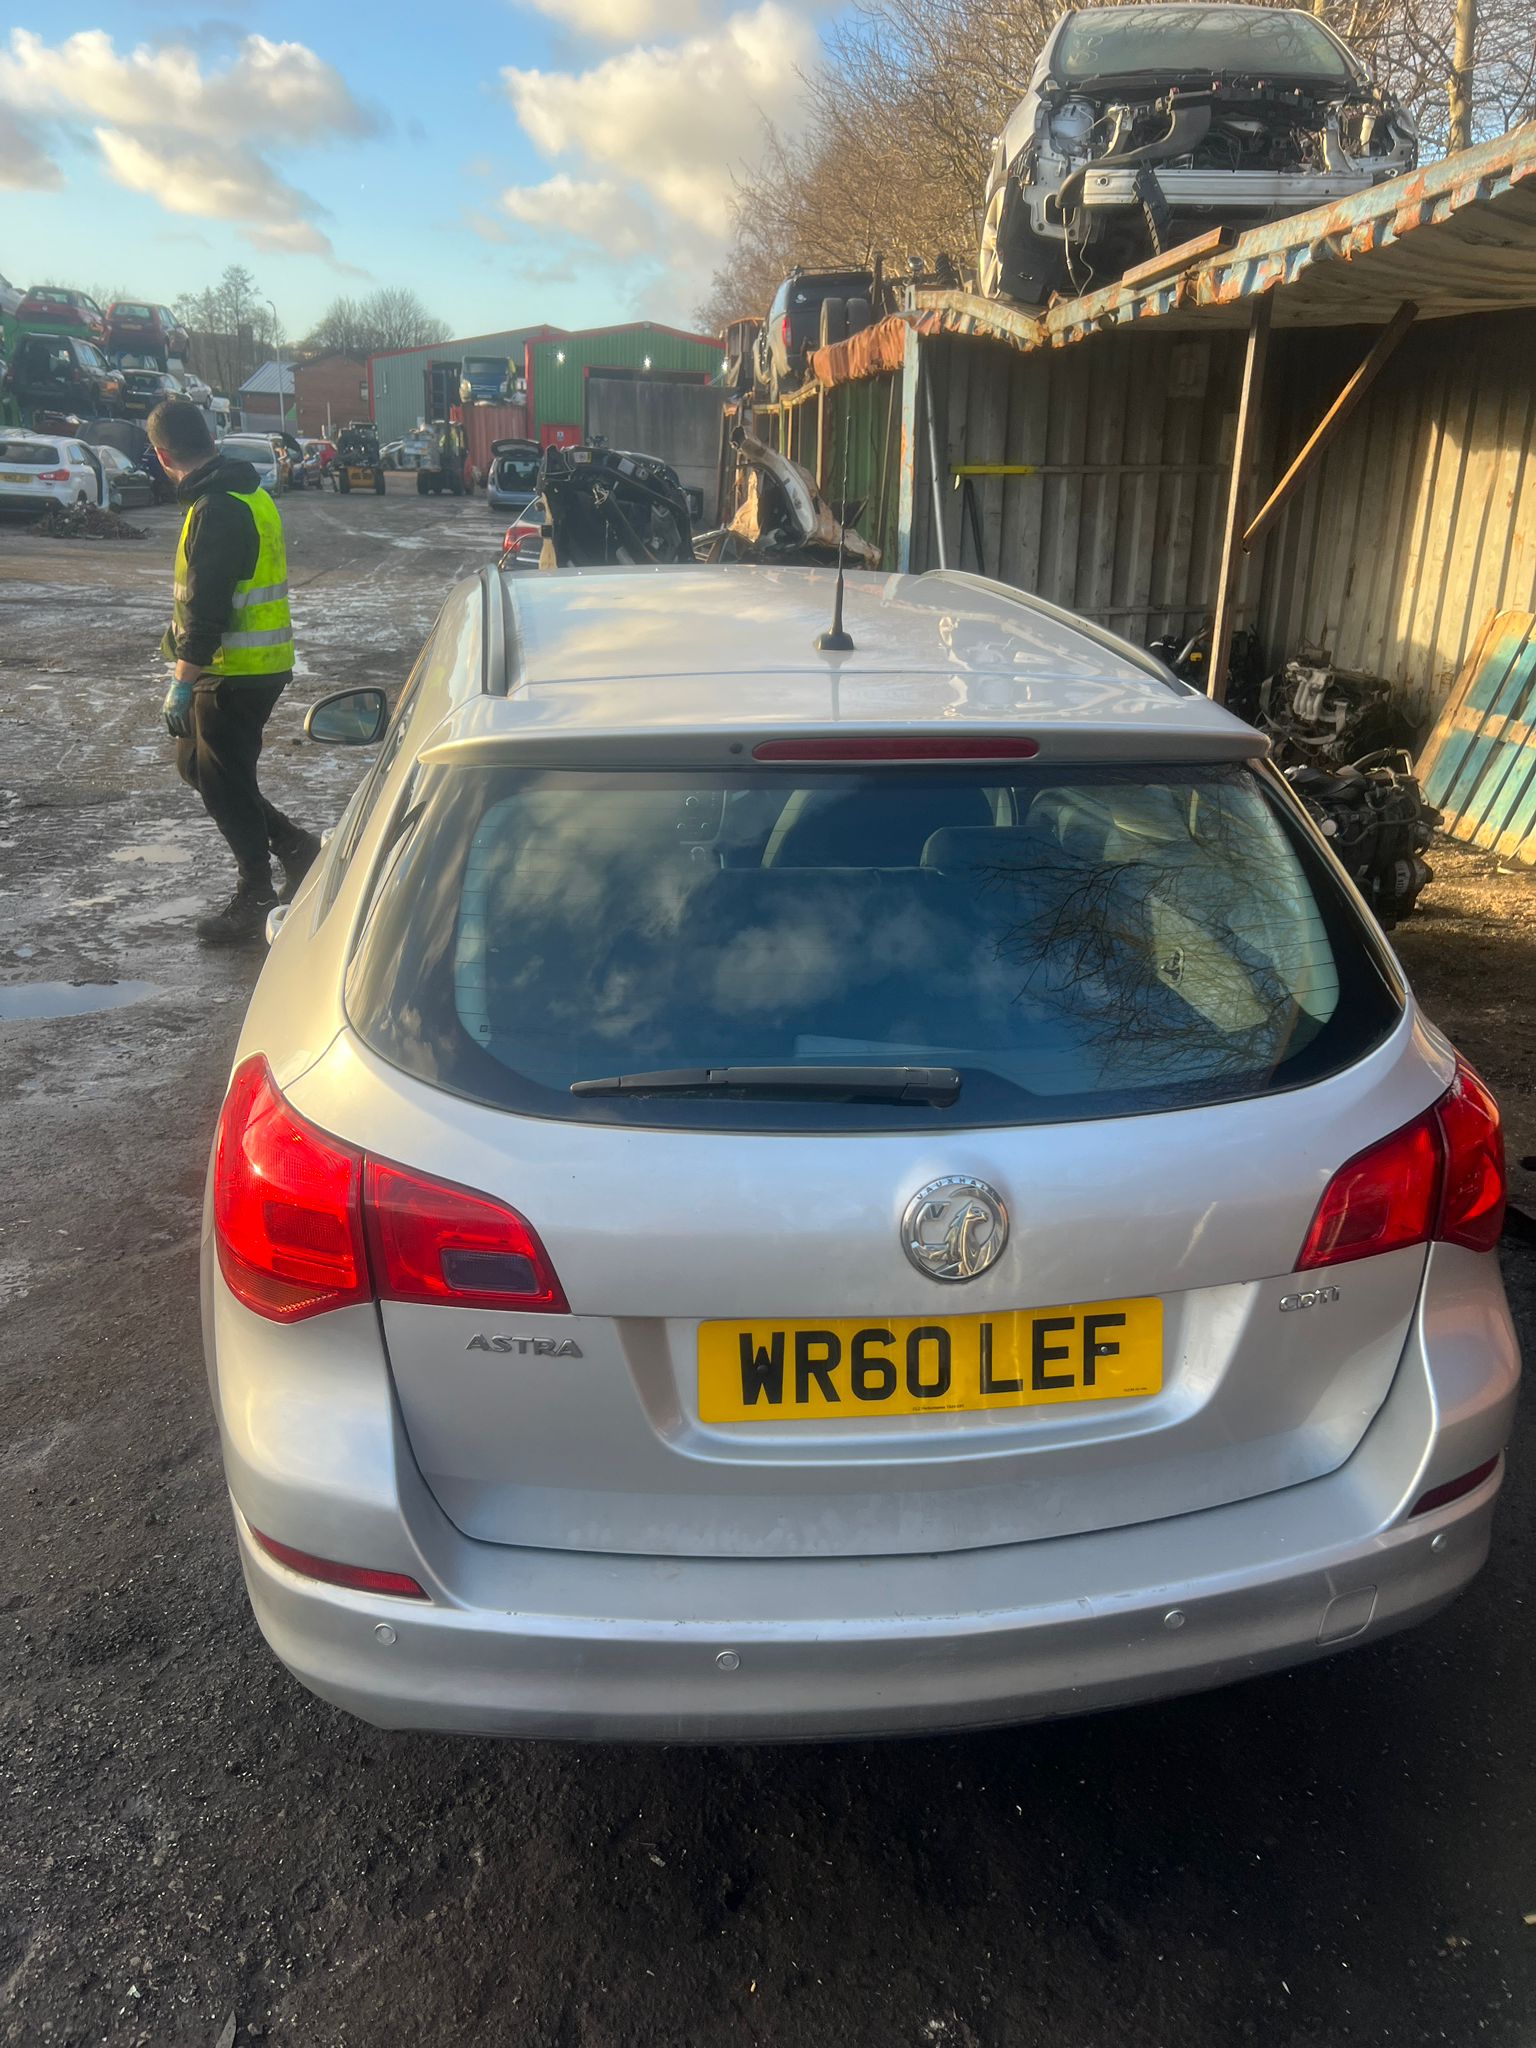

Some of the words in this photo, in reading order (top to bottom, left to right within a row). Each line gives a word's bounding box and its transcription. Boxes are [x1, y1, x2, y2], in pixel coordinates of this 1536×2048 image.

[465, 1334, 584, 1358] ASTRA
[738, 1325, 951, 1406] WR60
[979, 1313, 1126, 1394] LEF
